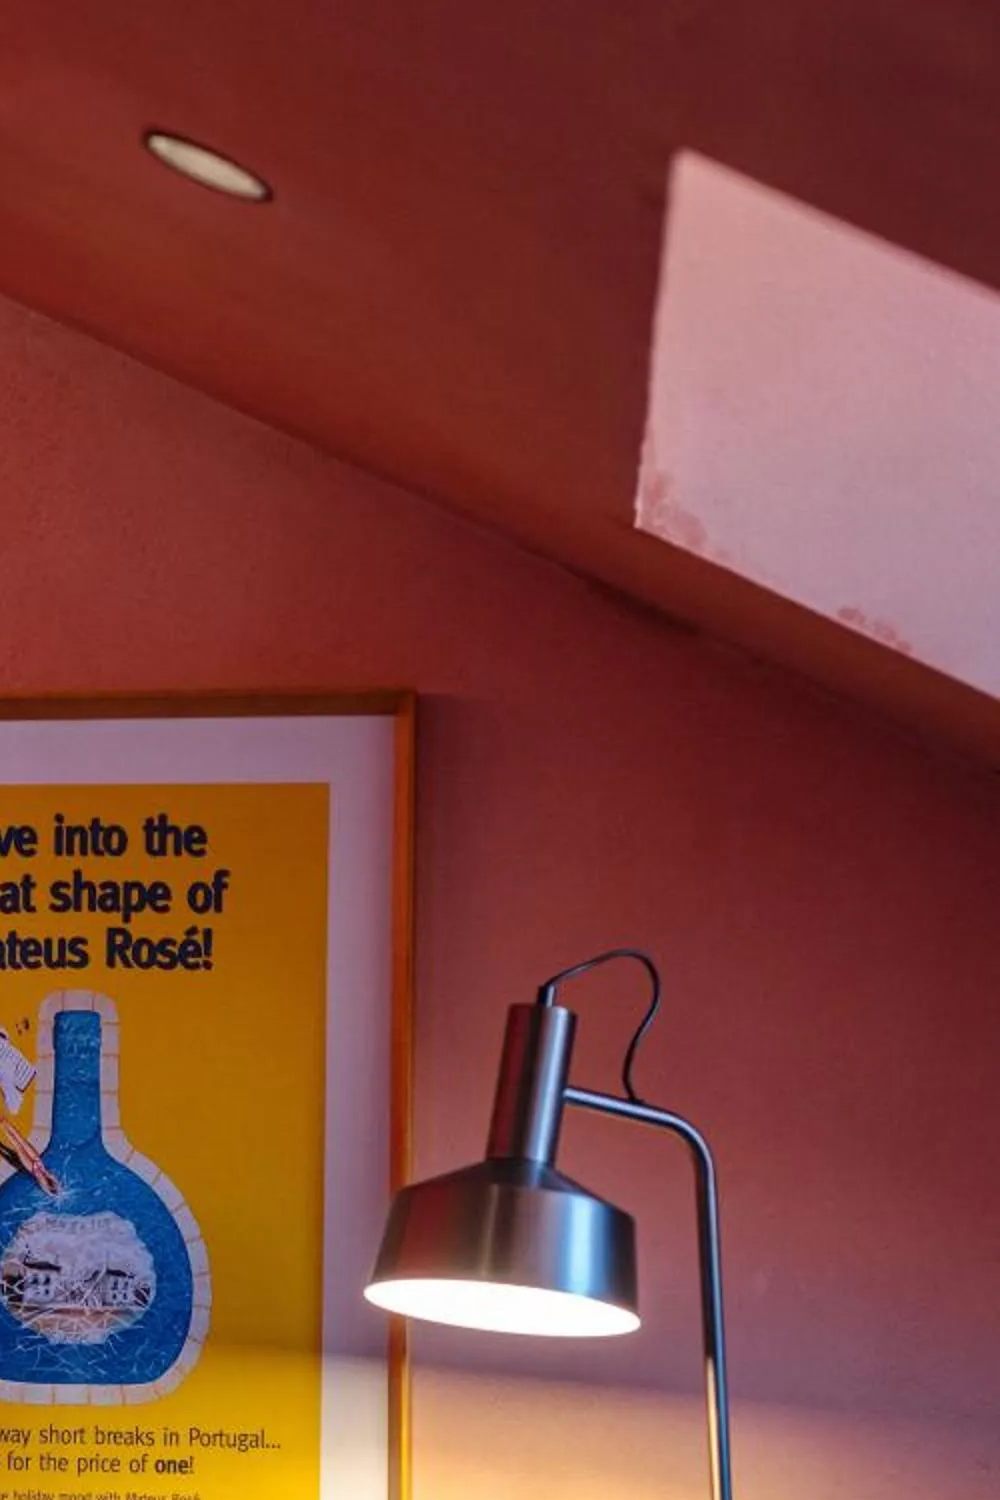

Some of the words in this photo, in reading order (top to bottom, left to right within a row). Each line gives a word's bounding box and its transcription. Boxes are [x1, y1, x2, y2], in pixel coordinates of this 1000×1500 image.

[53, 812, 128, 857] into
[142, 812, 208, 857] the
[48, 868, 172, 923] shape
[186, 868, 230, 914] of
[104, 926, 214, 971] Rosé!
[39, 1424, 86, 1445] short
[94, 1425, 155, 1447] breaks
[162, 1427, 180, 1447] in
[188, 1427, 282, 1452] Portugal...
[7, 1451, 32, 1471] for
[39, 1452, 69, 1472] the
[76, 1453, 121, 1477] price
[128, 1453, 149, 1473] of
[154, 1455, 195, 1475] one!
